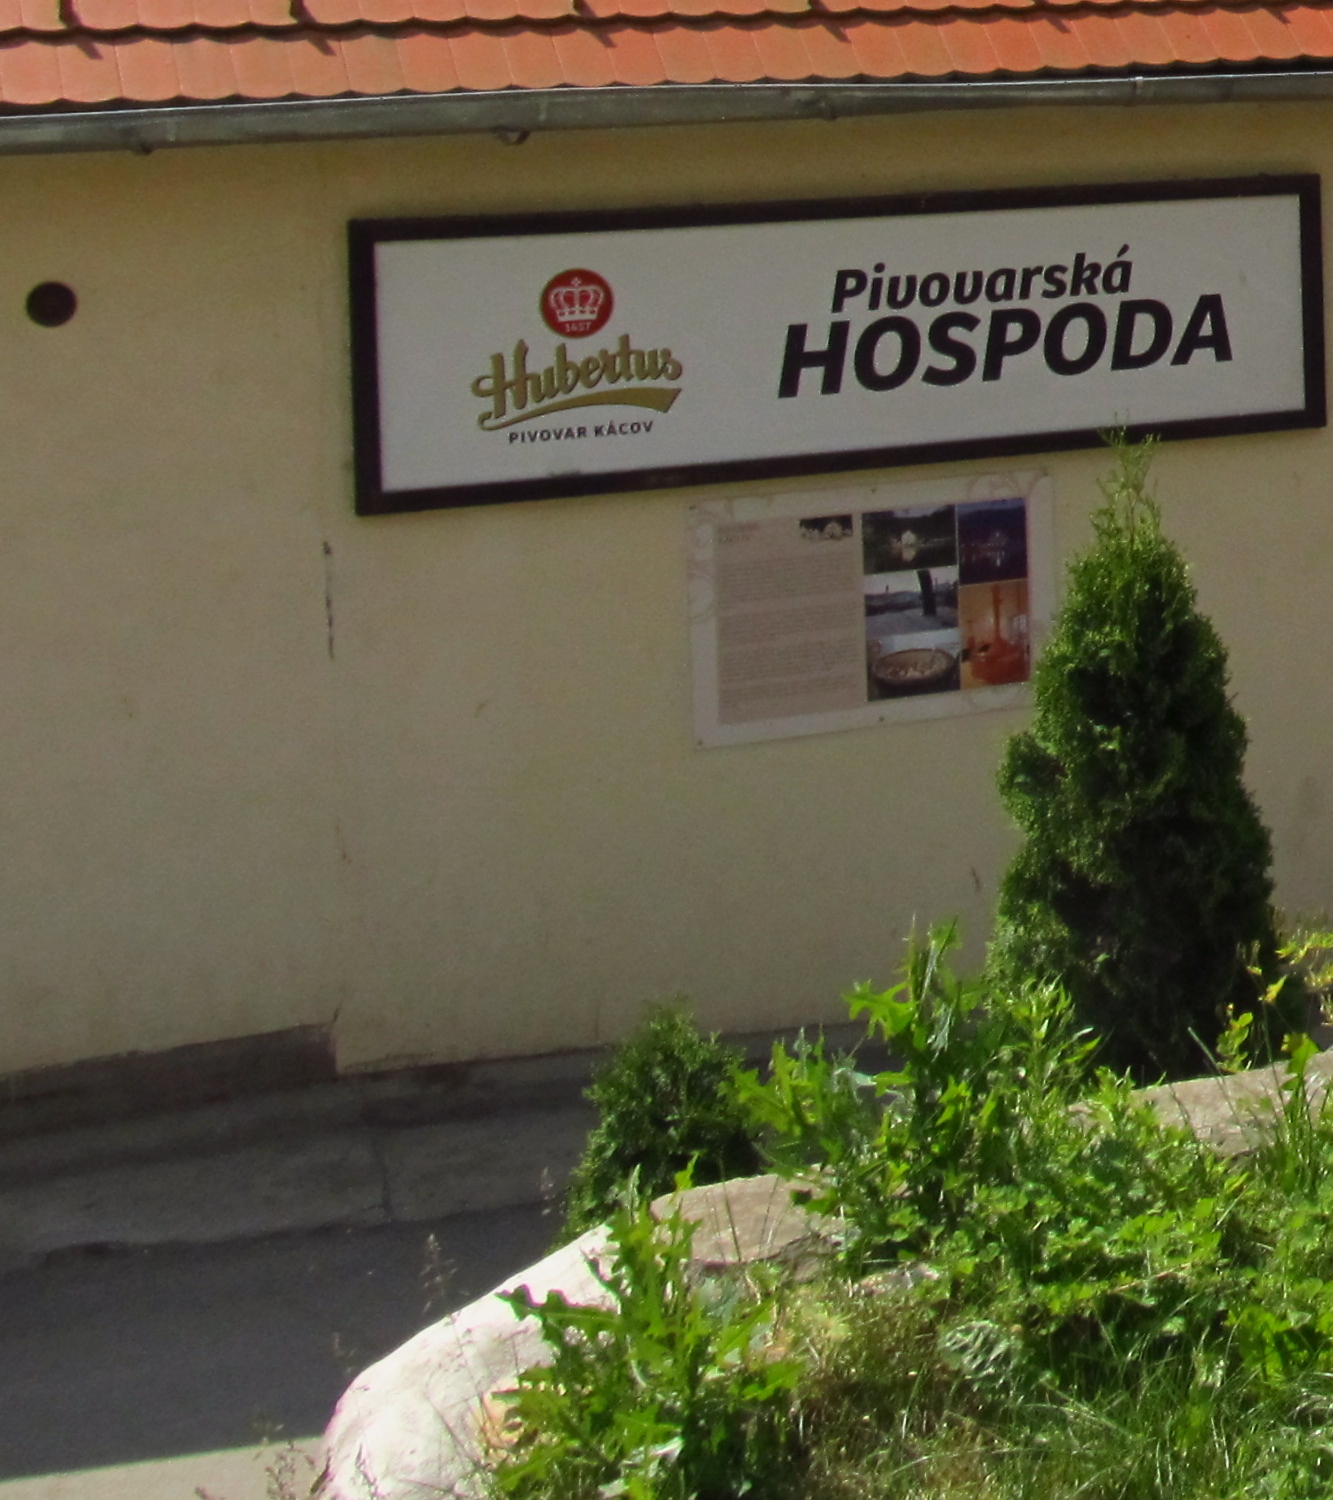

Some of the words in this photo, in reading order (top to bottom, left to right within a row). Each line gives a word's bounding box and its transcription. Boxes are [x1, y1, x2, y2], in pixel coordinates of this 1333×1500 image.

[831, 244, 1133, 313] Pivovarská
[470, 333, 683, 419] Hubertus
[778, 293, 1234, 399] HOSPODA
[508, 426, 588, 444] PIVOVAR
[594, 420, 654, 438] KÁCOV
